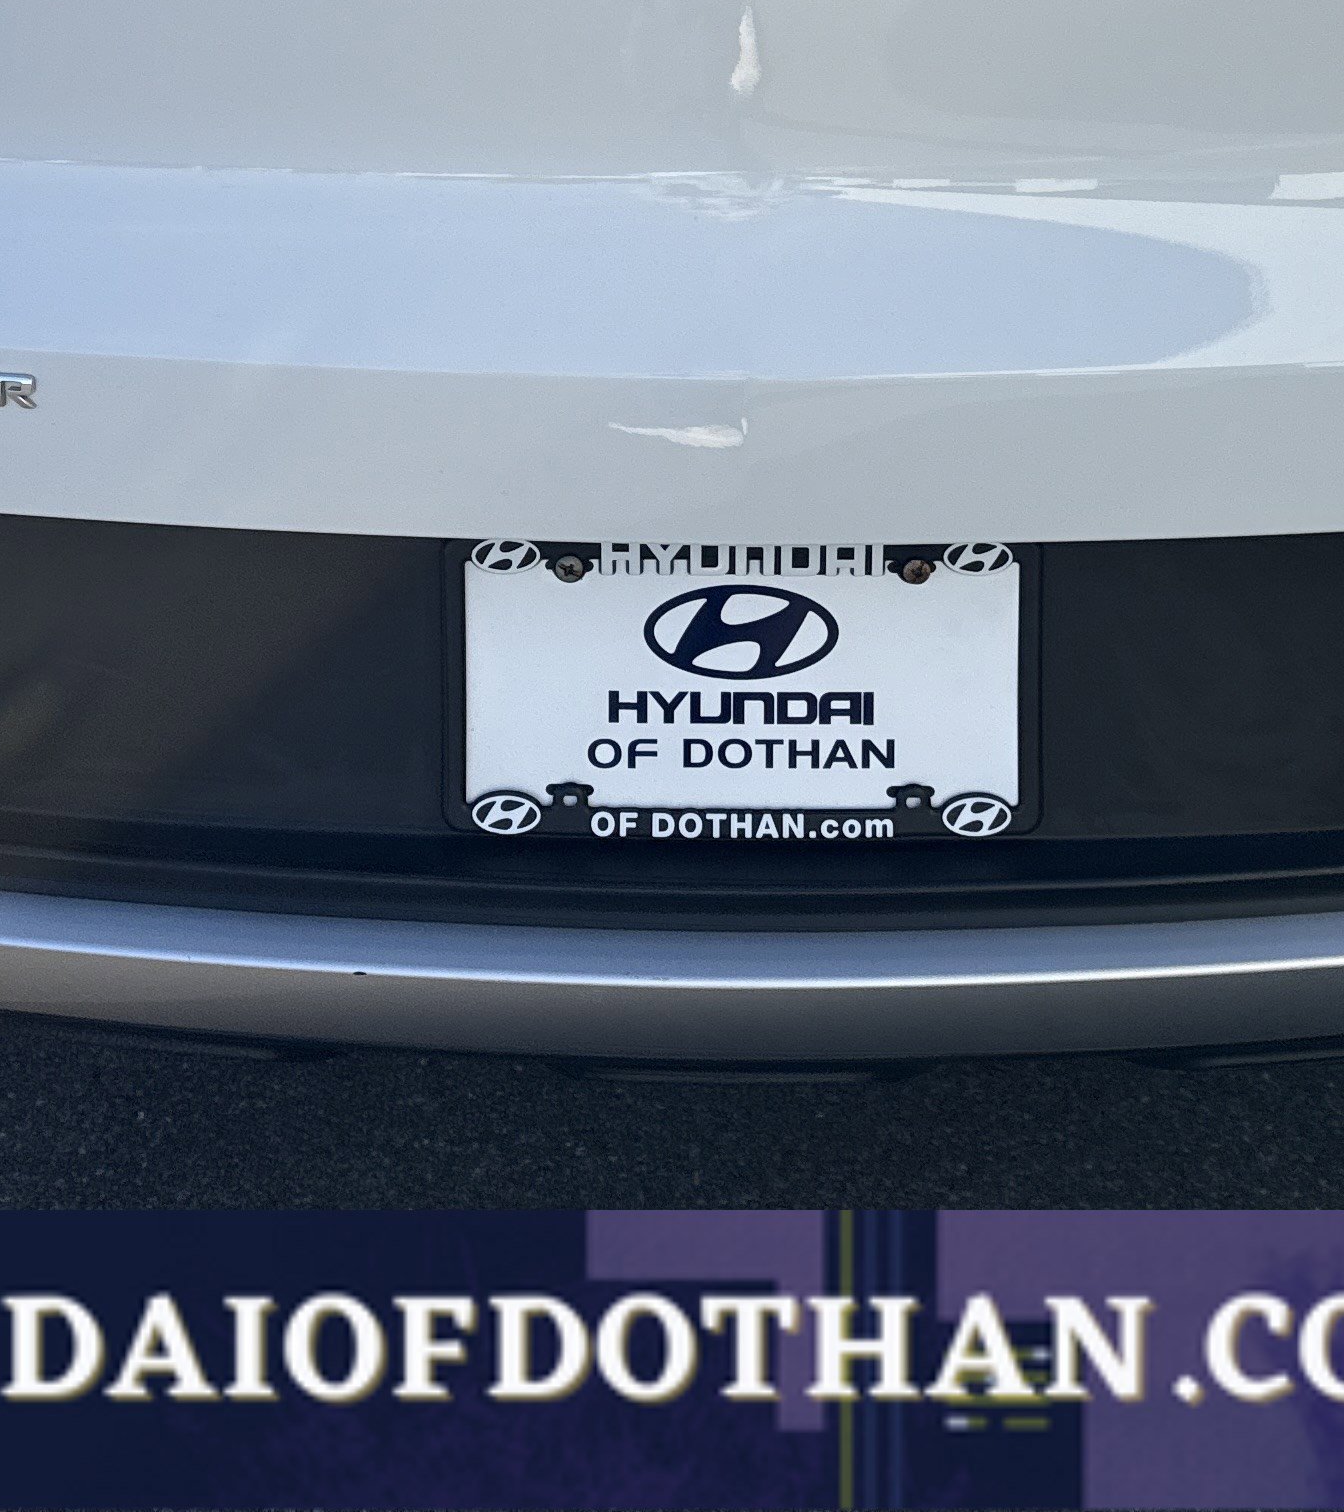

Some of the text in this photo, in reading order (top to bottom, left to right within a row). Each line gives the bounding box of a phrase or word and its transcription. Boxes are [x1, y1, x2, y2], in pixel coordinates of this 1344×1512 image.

[600, 543, 885, 576] HYUNDAI
[608, 691, 874, 725] HYUNDAI
[587, 739, 895, 769] OF DOTHAN
[591, 812, 894, 839] OF DOTHAN.com
